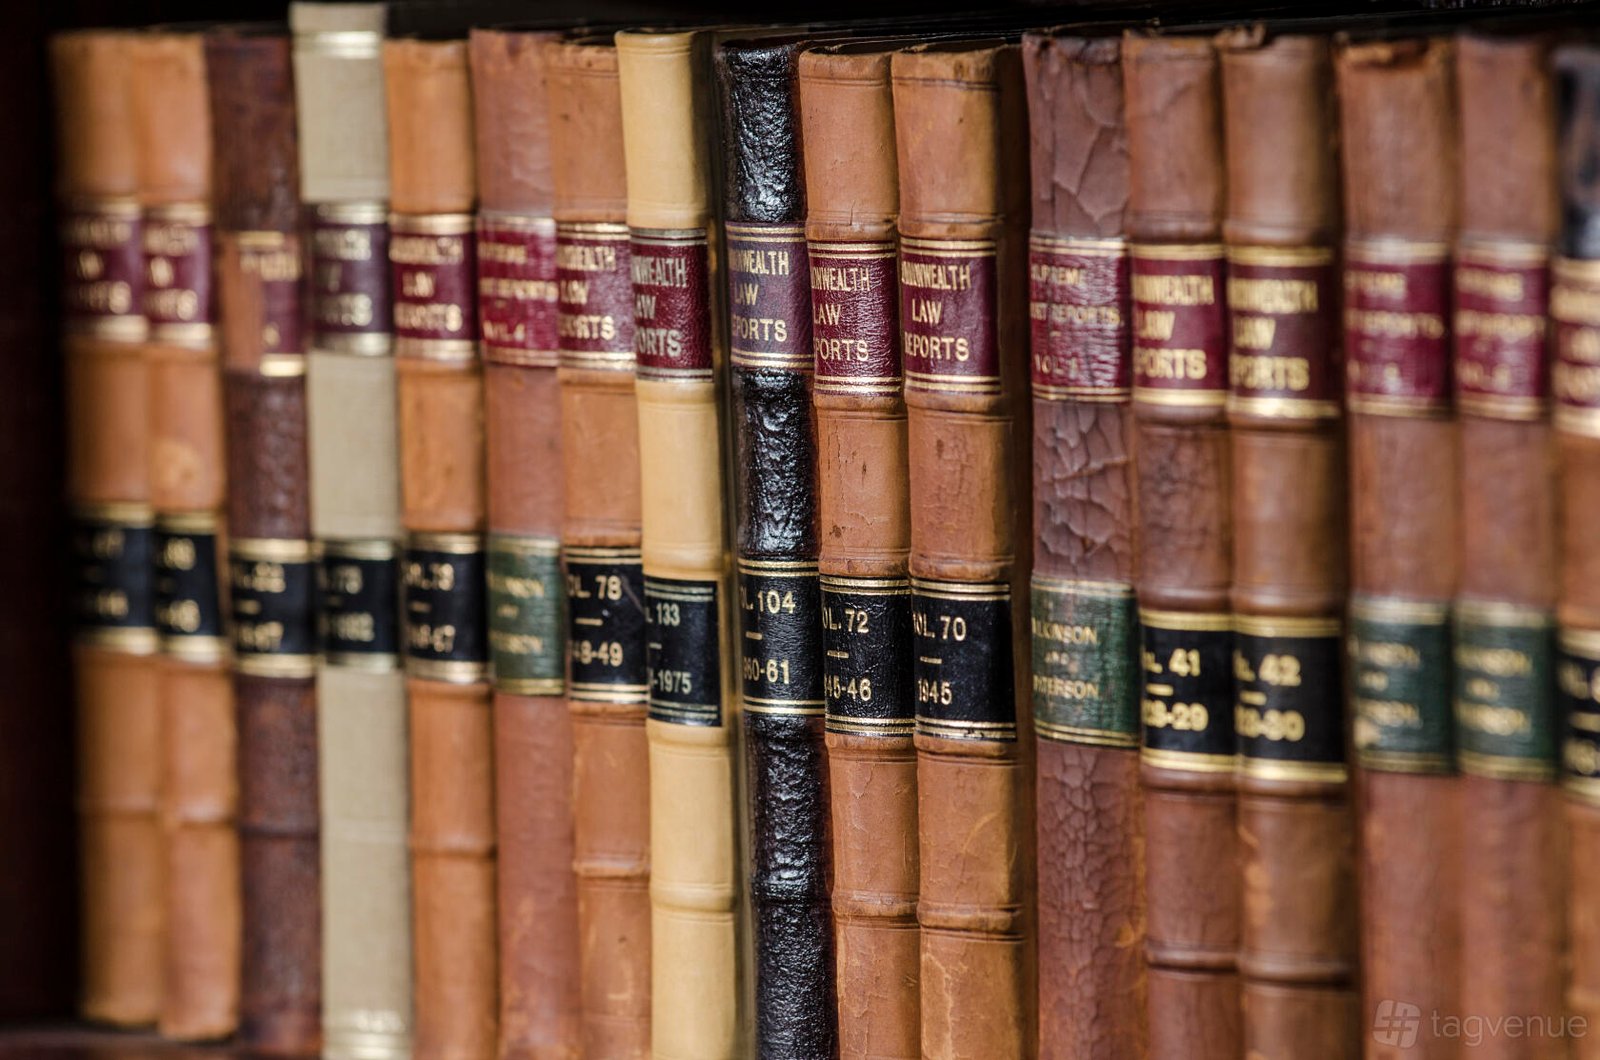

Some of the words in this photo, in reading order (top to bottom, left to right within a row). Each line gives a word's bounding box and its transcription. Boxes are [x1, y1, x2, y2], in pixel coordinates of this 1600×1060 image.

[734, 282, 759, 306] LAW
[813, 303, 841, 326] LAW
[912, 299, 942, 325] LAW
[595, 575, 623, 600] 78
[757, 589, 797, 614] 104
[656, 602, 681, 627] 133
[844, 608, 870, 634] 72
[940, 615, 967, 642] 70
[918, 678, 953, 706] 1945
